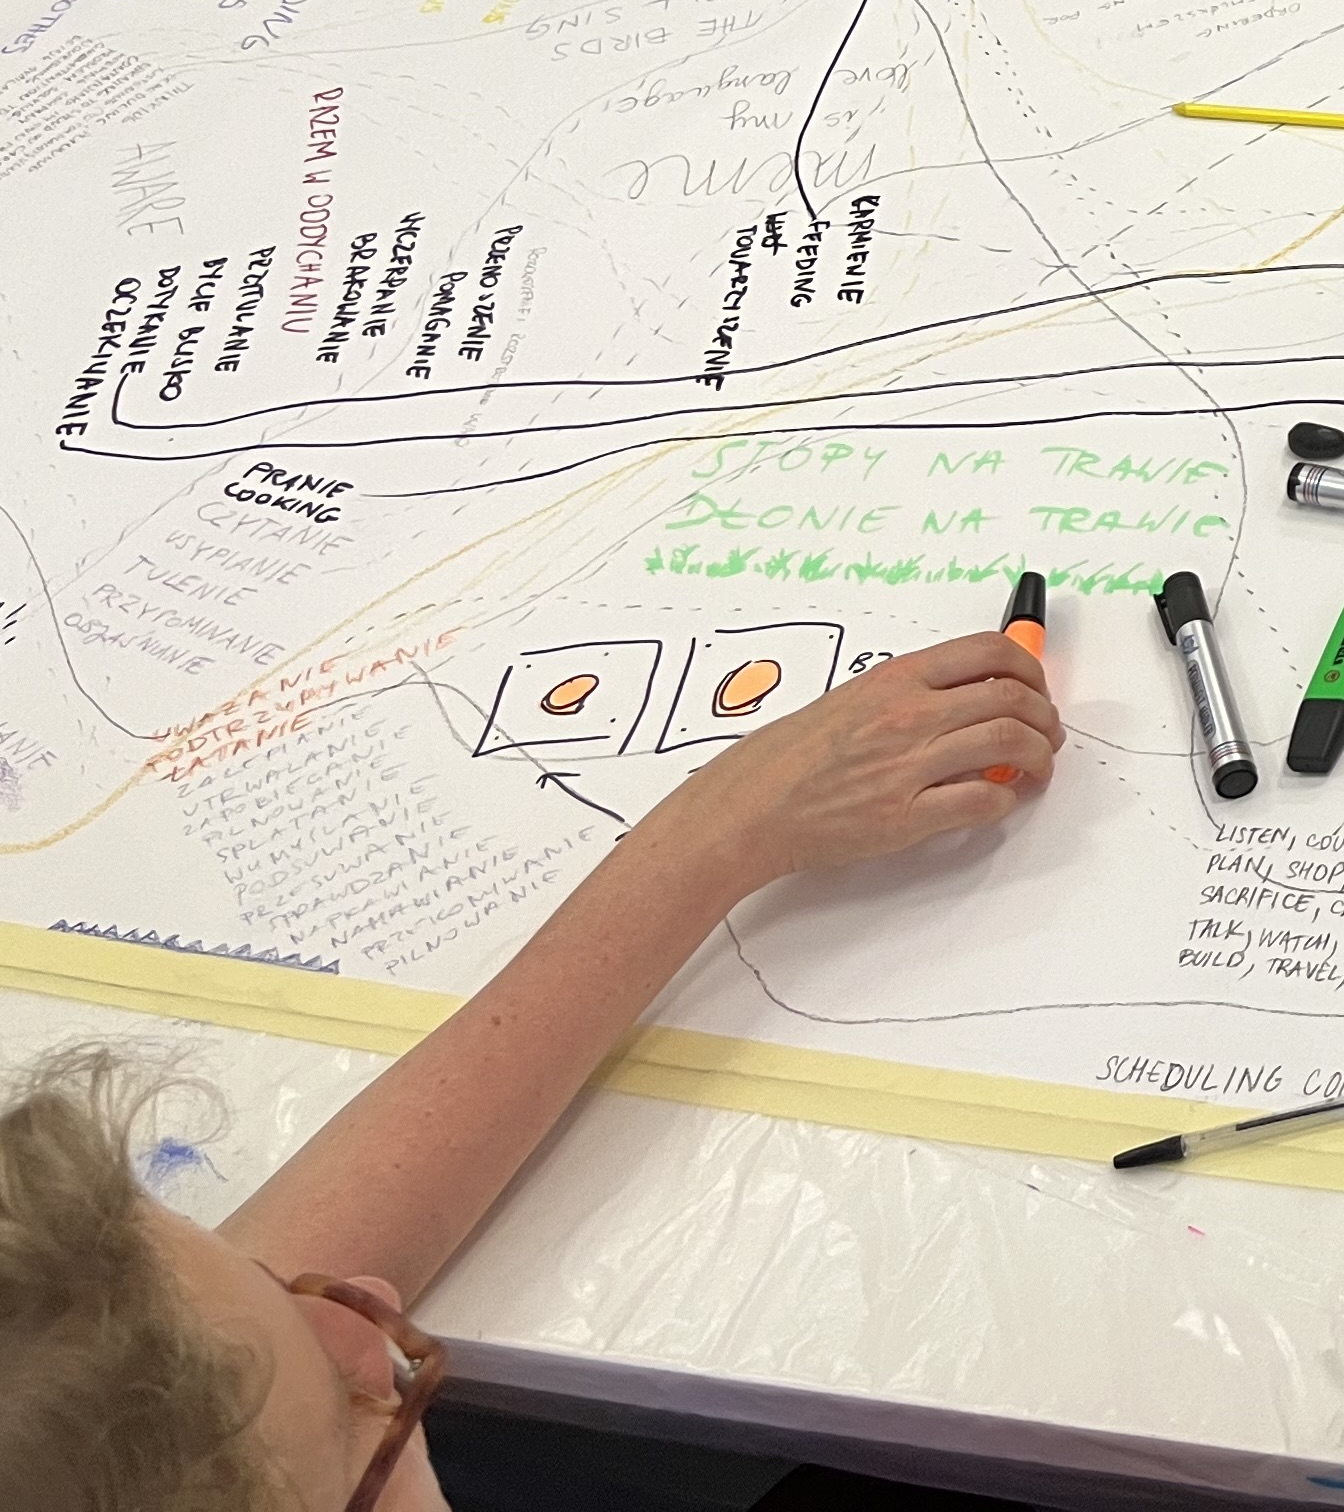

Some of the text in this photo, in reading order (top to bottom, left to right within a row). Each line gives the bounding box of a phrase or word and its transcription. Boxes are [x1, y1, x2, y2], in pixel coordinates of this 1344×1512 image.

[242, 461, 355, 499] PRANIE
[926, 449, 1006, 478] NA
[223, 481, 342, 524] COOKING
[921, 507, 996, 535] NA
[1215, 823, 1297, 852] LISTEN,
[1199, 885, 1321, 924] SACRIFICE,
[1095, 1055, 1283, 1095] SCHEDULING
